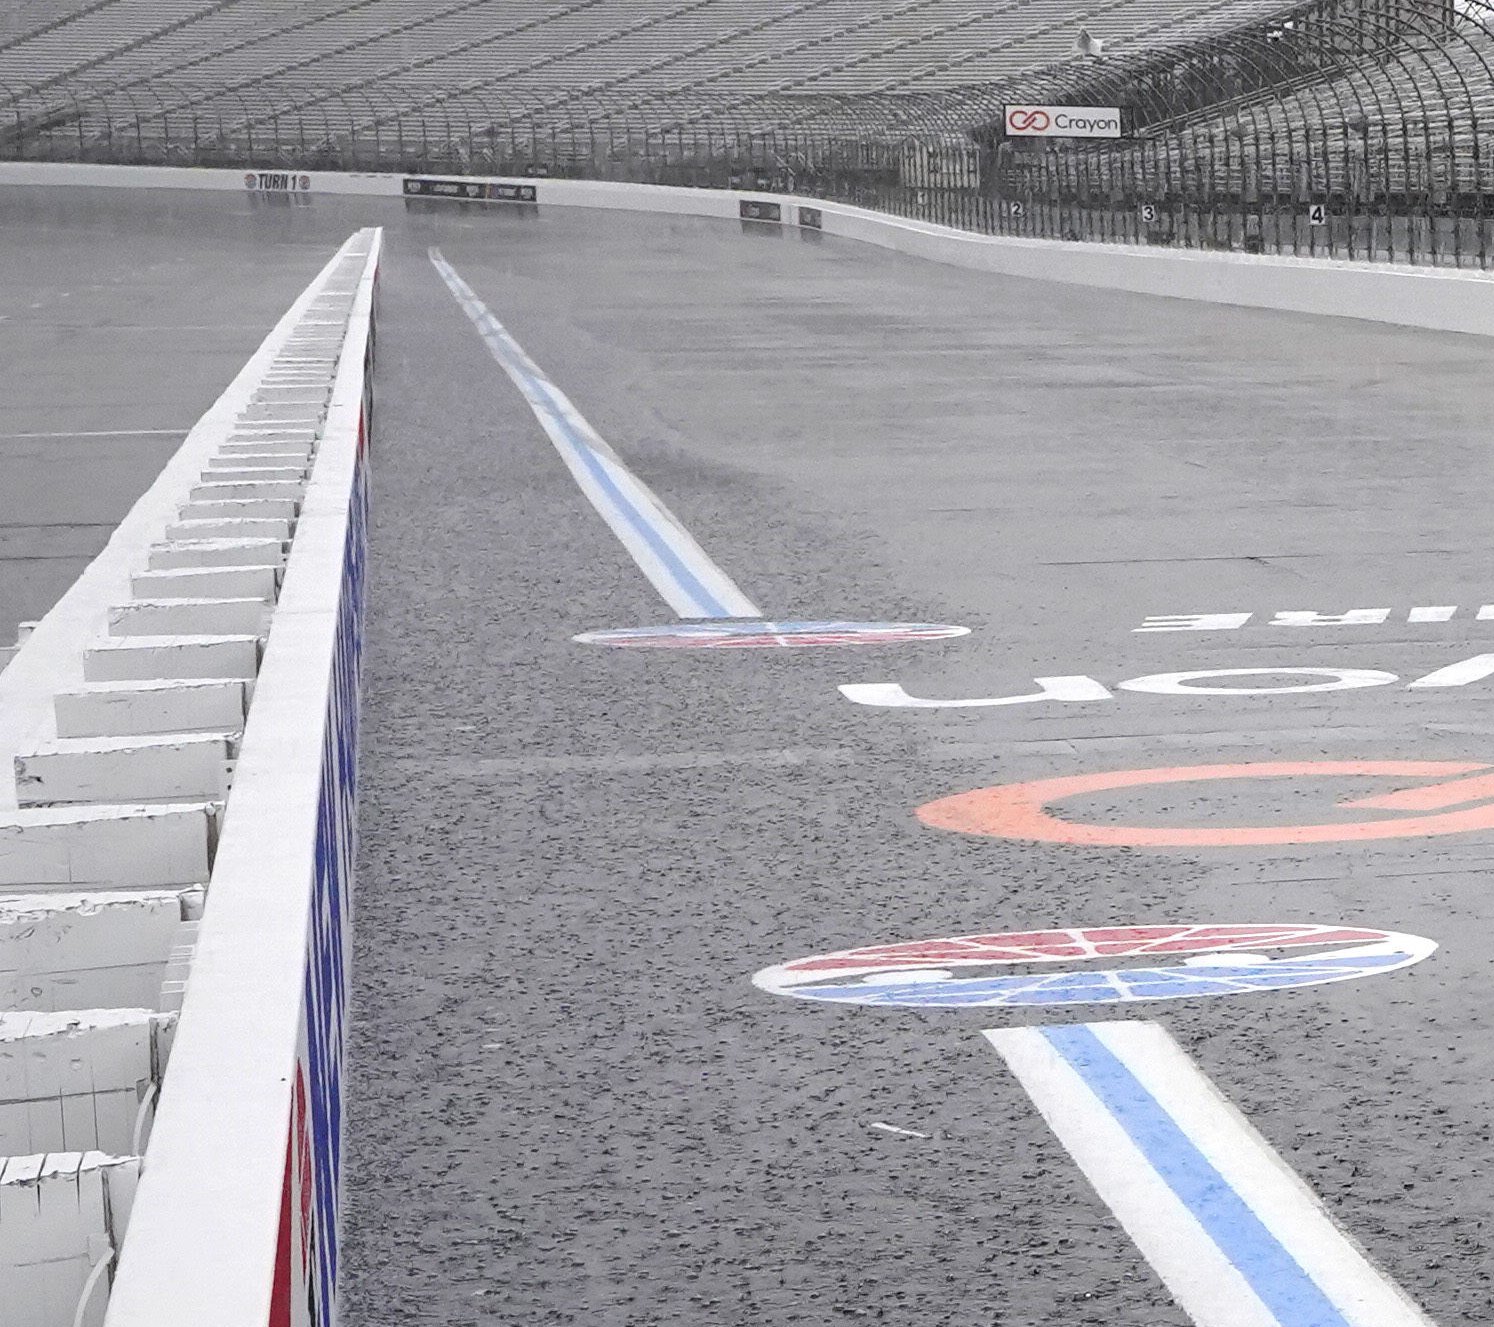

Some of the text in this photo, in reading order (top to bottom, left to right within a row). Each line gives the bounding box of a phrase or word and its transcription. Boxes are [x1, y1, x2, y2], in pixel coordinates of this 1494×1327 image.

[1054, 113, 1118, 133] Crayon
[258, 173, 288, 190] TURN
[1143, 206, 1154, 221] 3
[1311, 206, 1324, 224] 4
